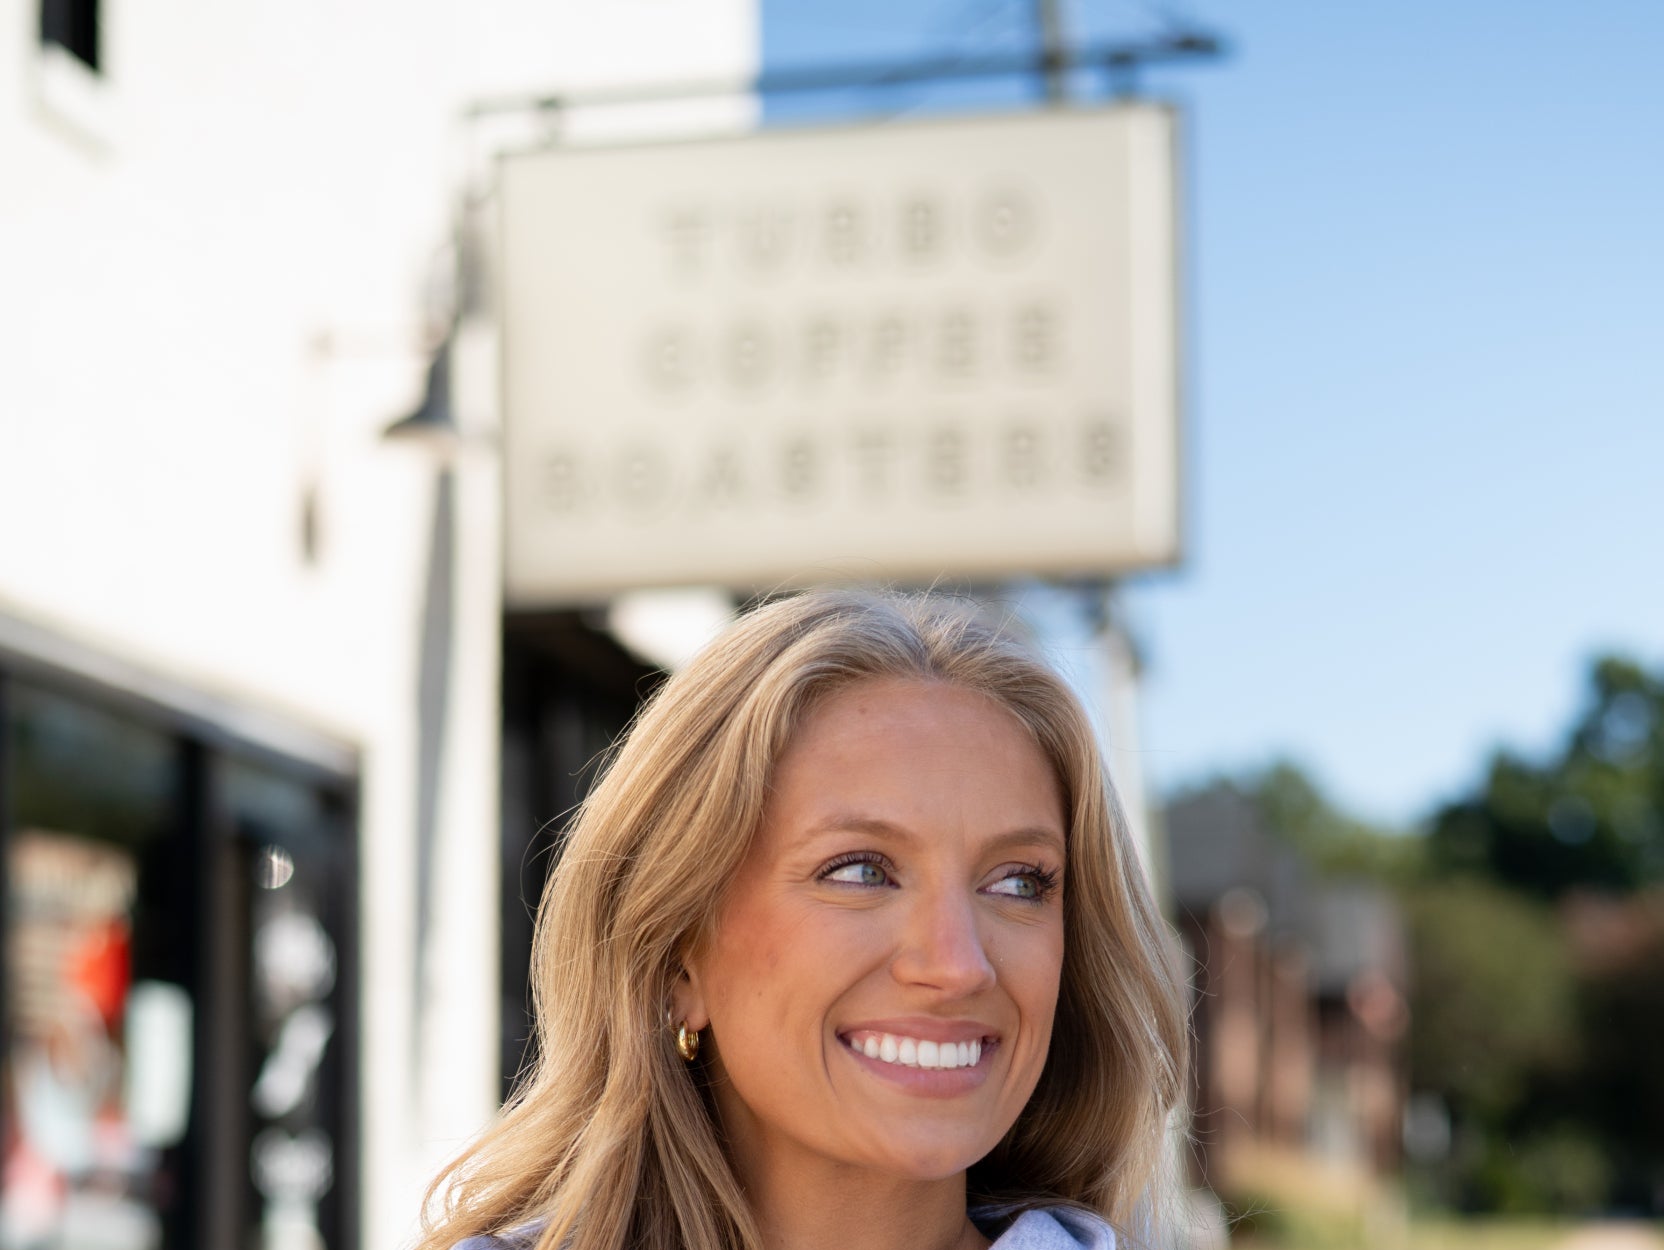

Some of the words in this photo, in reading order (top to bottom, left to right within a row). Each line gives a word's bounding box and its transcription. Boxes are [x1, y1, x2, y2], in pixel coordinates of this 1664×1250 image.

[658, 186, 1038, 280] TURBO
[638, 300, 1062, 396] COFFEE
[538, 414, 1126, 512] ROASTERS
